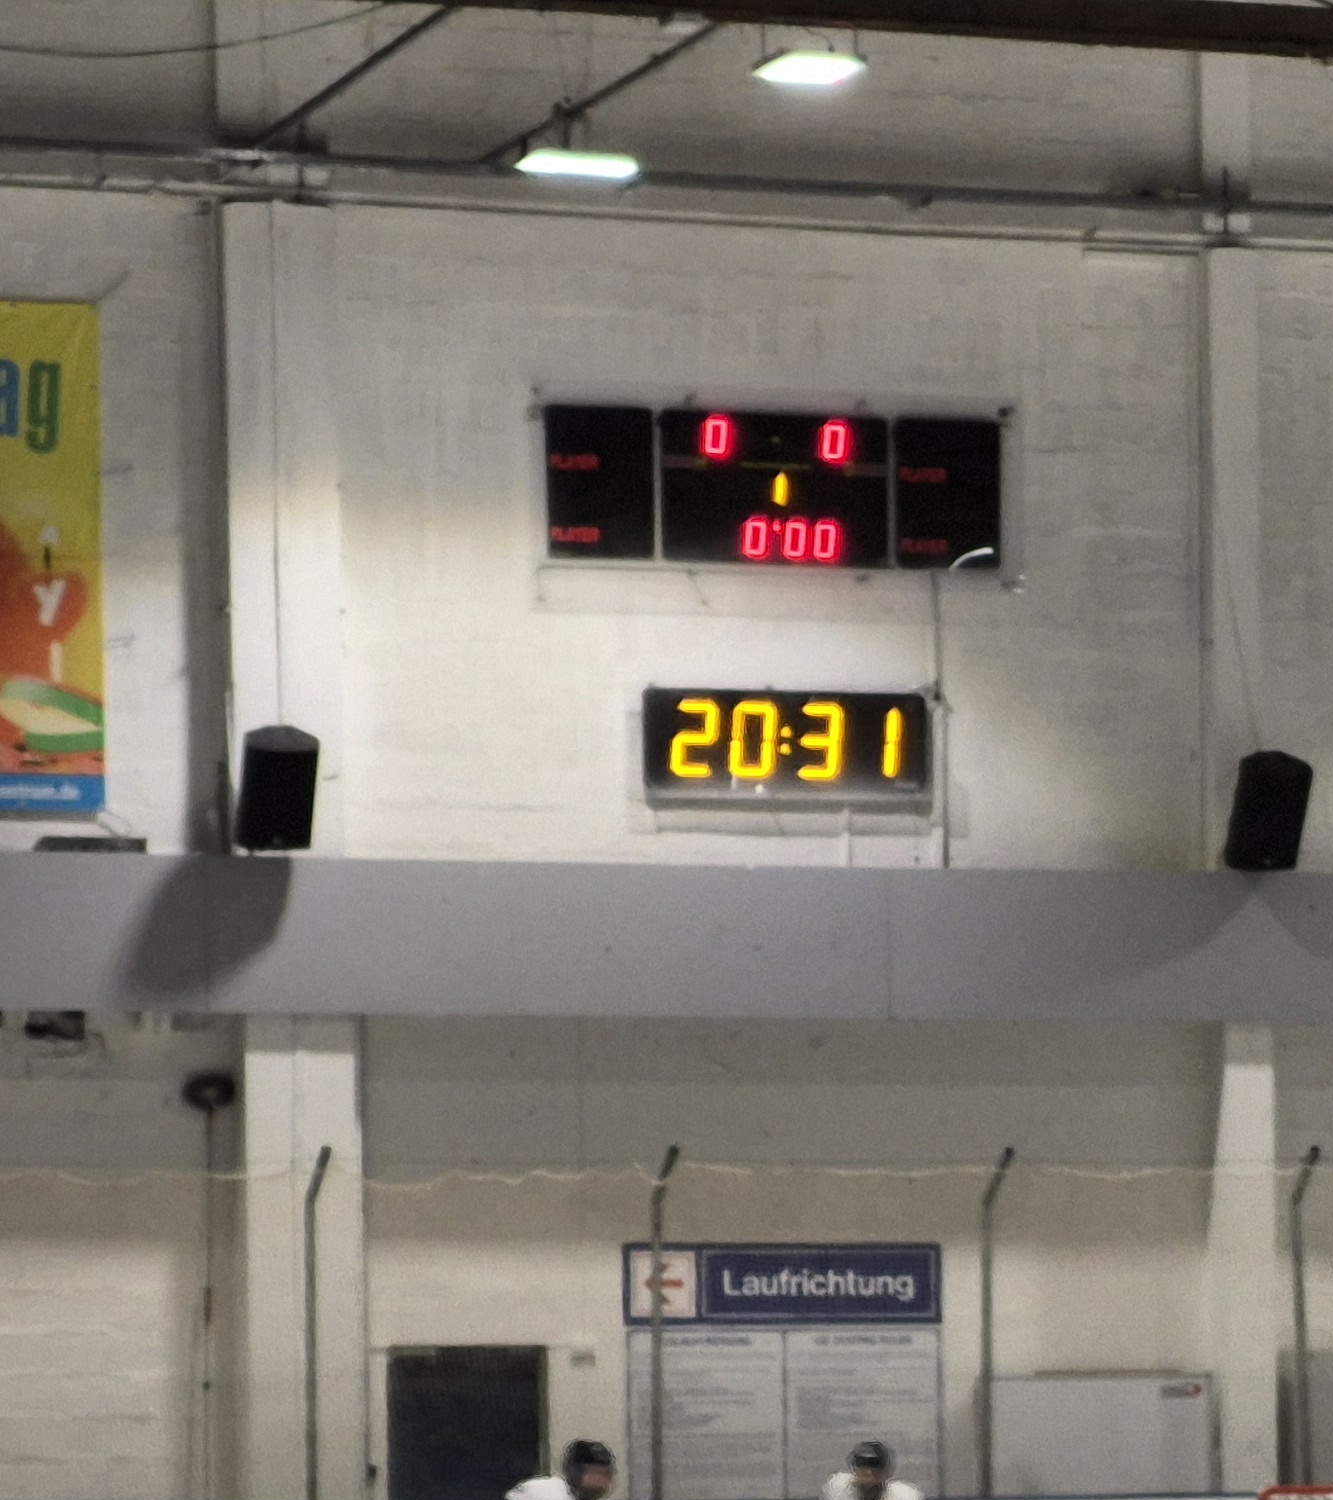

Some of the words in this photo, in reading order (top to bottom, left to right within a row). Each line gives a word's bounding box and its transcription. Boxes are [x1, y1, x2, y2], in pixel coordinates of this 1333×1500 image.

[702, 415, 734, 458] 0
[819, 420, 850, 463] 0
[773, 472, 790, 507] 1
[669, 699, 903, 779] 20:31
[721, 1267, 915, 1302] Laufrichtung
